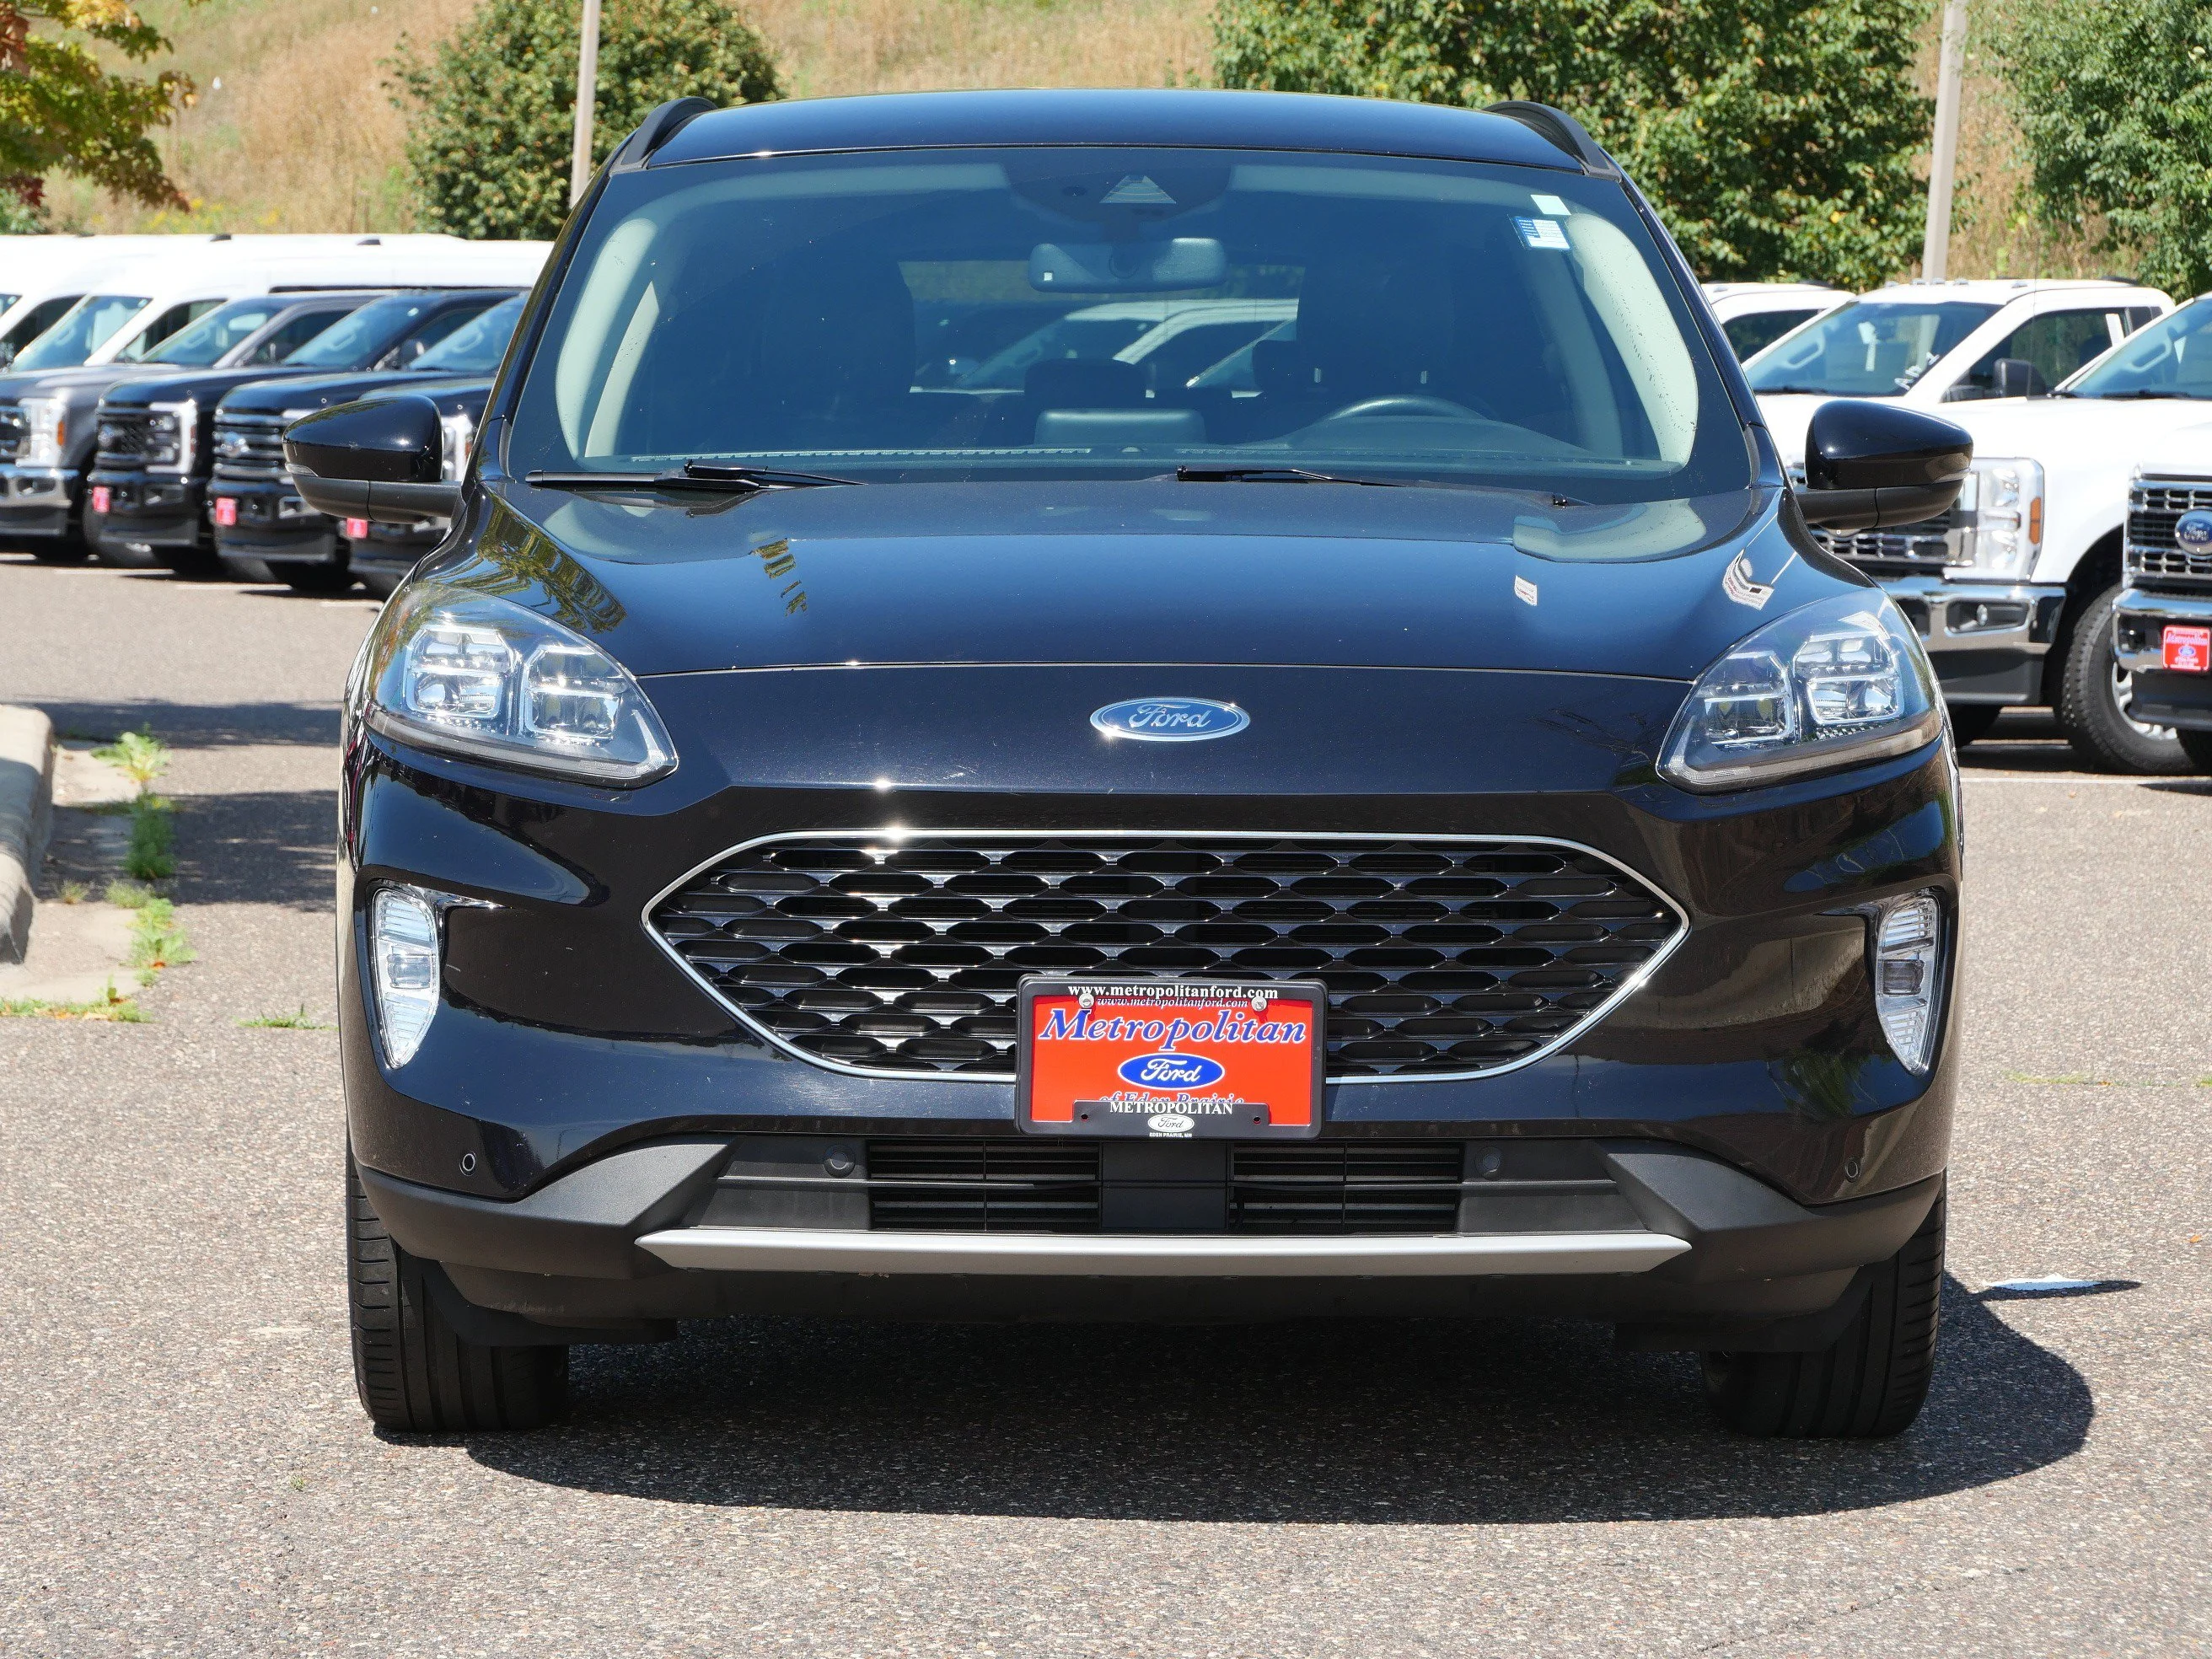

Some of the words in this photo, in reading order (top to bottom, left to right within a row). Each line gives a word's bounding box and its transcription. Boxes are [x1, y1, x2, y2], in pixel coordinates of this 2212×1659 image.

[1128, 702, 1213, 728] Ford
[1067, 985, 1279, 1001] www.metropolitanford.com
[1097, 996, 1248, 1010] www.metropolitanford.com
[1038, 1008, 1306, 1052] Metropolitan
[1140, 1057, 1203, 1083] Ford
[1109, 1101, 1233, 1115] METROPOLITAN
[1157, 1117, 1185, 1130] Ford
